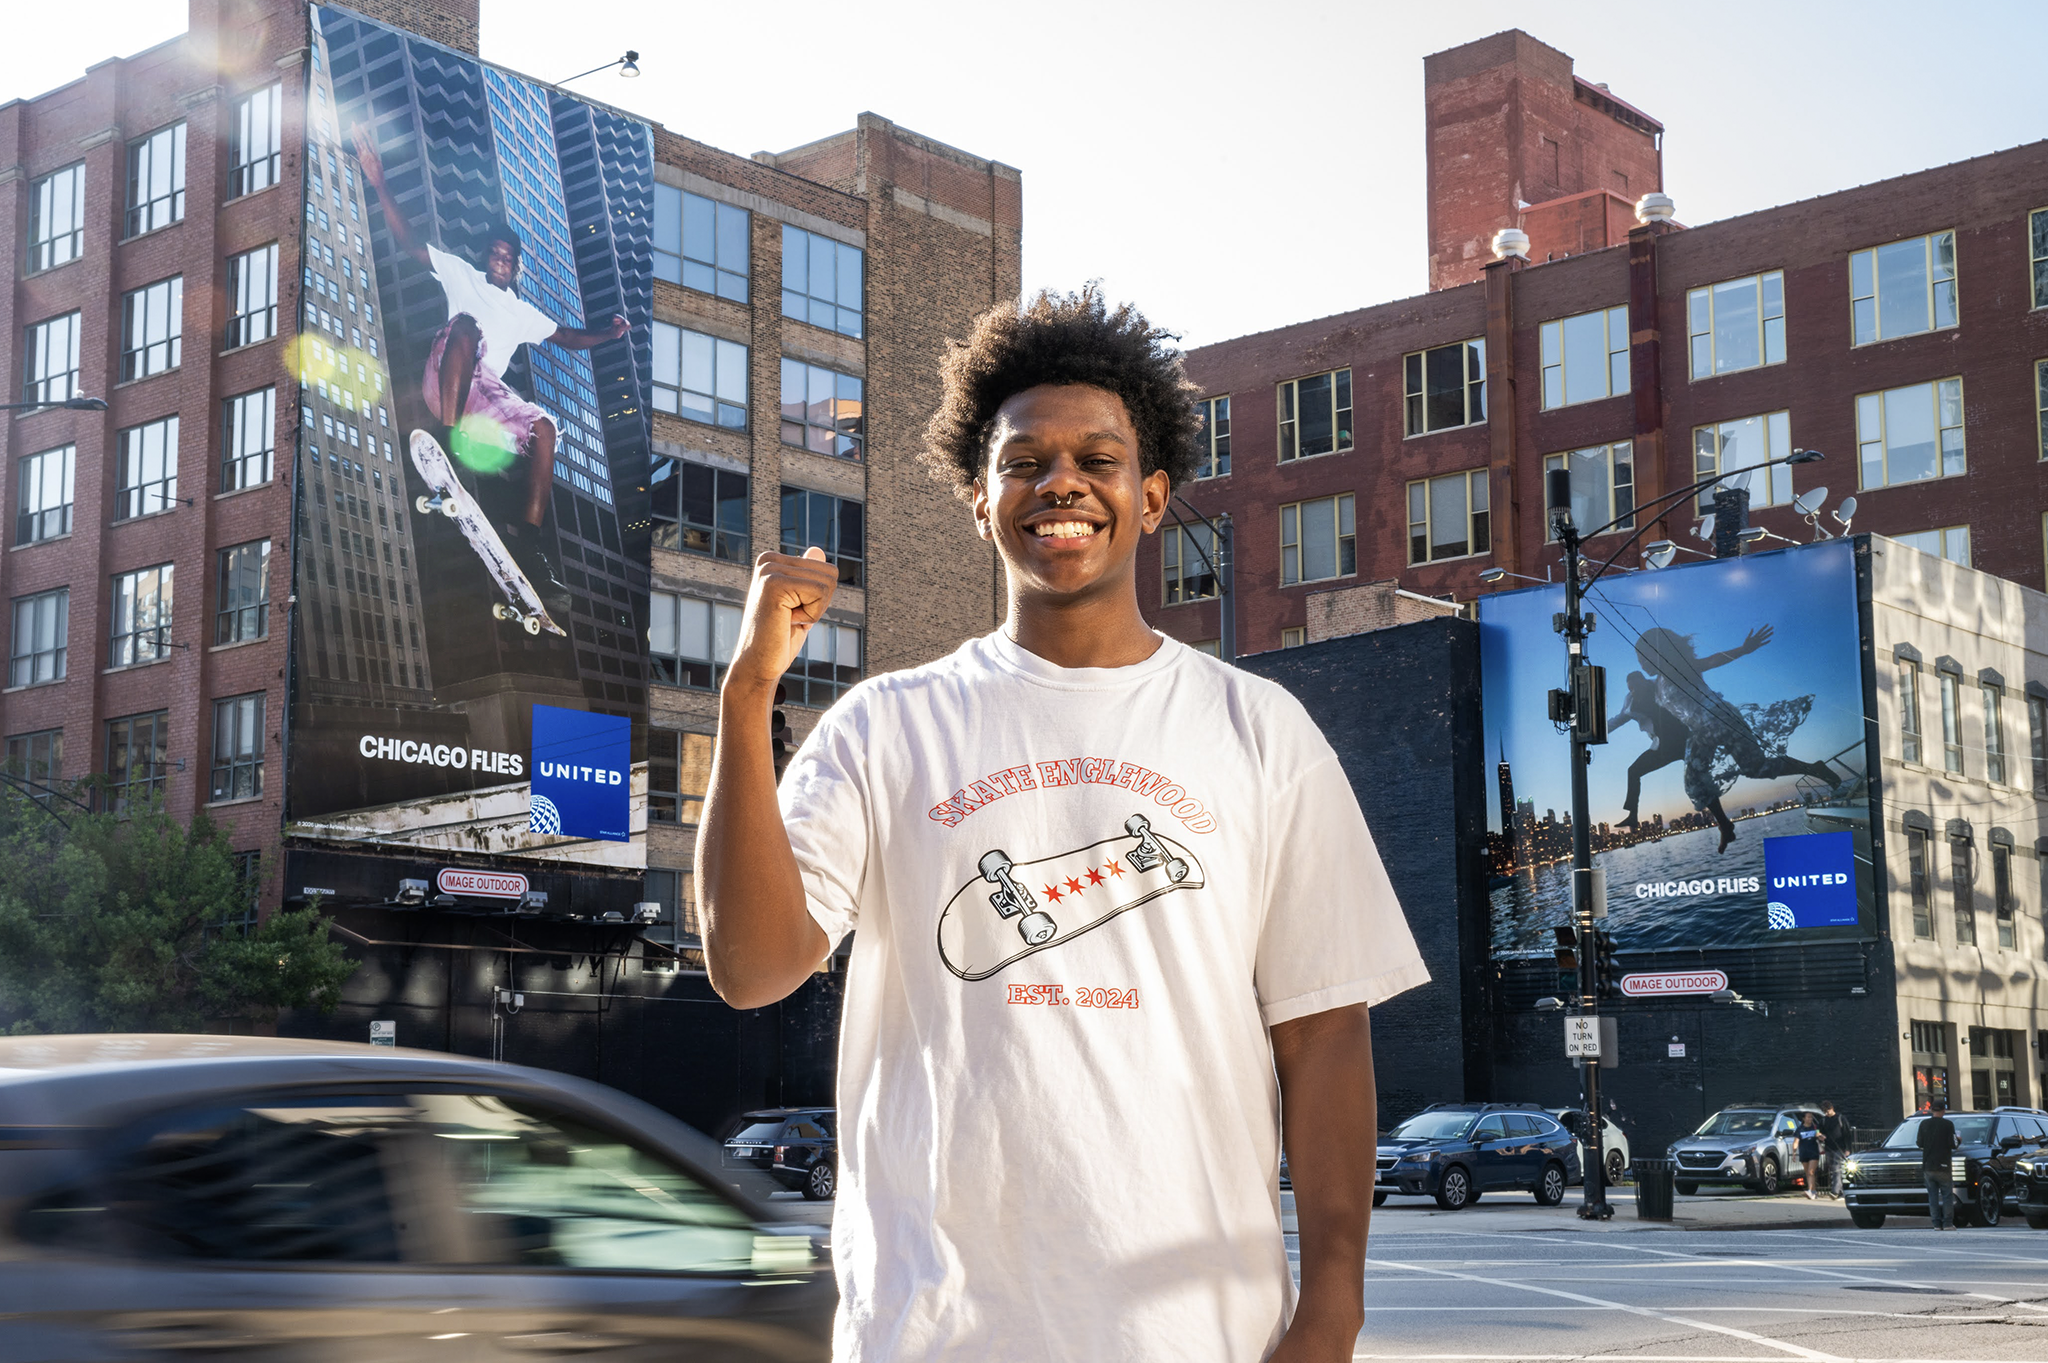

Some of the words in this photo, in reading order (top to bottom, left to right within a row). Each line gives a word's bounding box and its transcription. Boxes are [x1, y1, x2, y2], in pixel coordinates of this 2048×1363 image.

[360, 736, 467, 769] CHICAGO
[471, 749, 523, 776] FLIES
[540, 762, 622, 786] UNITED
[928, 764, 1037, 828] SKATE
[1036, 757, 1217, 834] ENGLEWOOD
[445, 875, 474, 889] IMAGE
[477, 877, 520, 892] OUTDOOR
[1635, 879, 1715, 899] CHICAGO
[1718, 877, 1759, 893] FLIES
[1774, 873, 1847, 888] UNITED
[1629, 979, 1662, 990] IMAGE
[1665, 977, 1718, 989] OUTDOOR
[1007, 984, 1070, 1006] EST.
[1075, 987, 1139, 1009] 2024
[1575, 1021, 1588, 1029] NO
[1572, 1032, 1593, 1040] TURN
[1568, 1043, 1579, 1052] ON
[1583, 1043, 1597, 1051] RED
